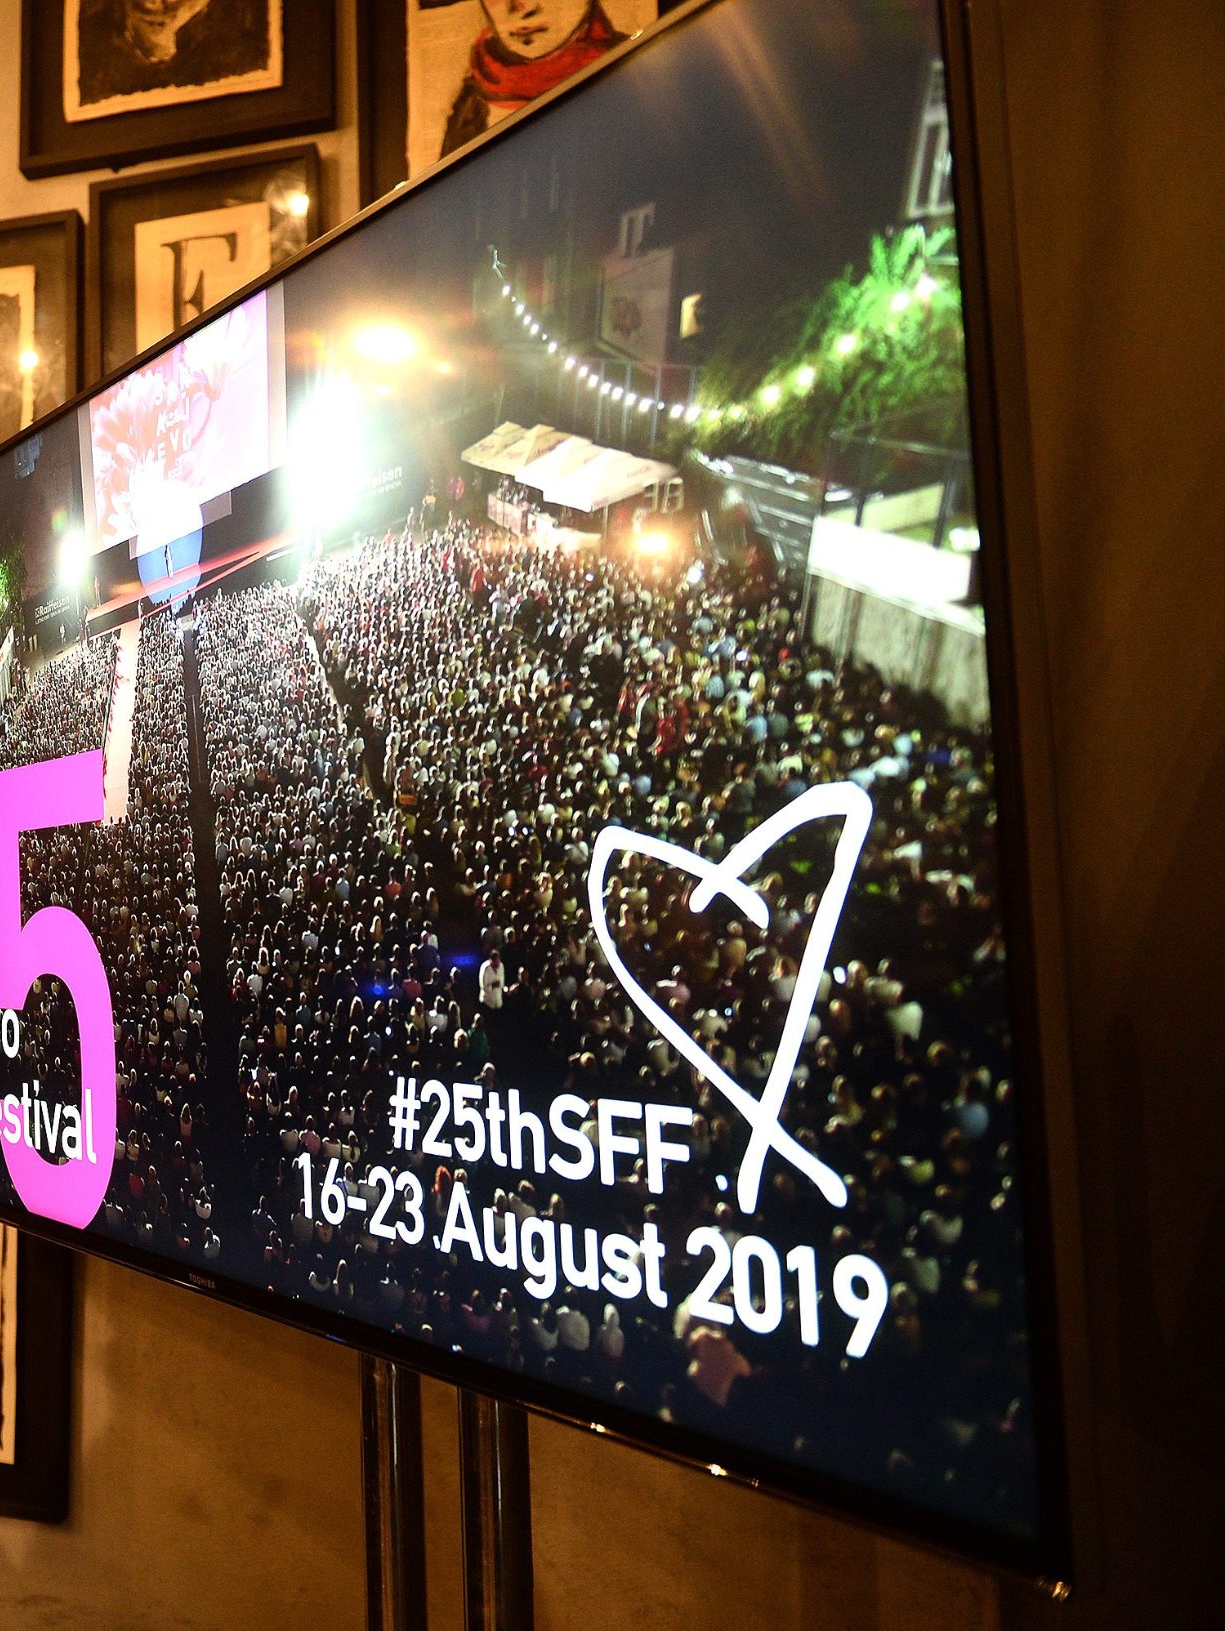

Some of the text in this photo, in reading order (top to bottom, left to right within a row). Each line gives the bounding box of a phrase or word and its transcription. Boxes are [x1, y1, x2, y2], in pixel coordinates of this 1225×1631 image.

[389, 1076, 693, 1195] #25thSFF
[439, 1180, 668, 1308] August
[685, 1226, 889, 1359] 2019
